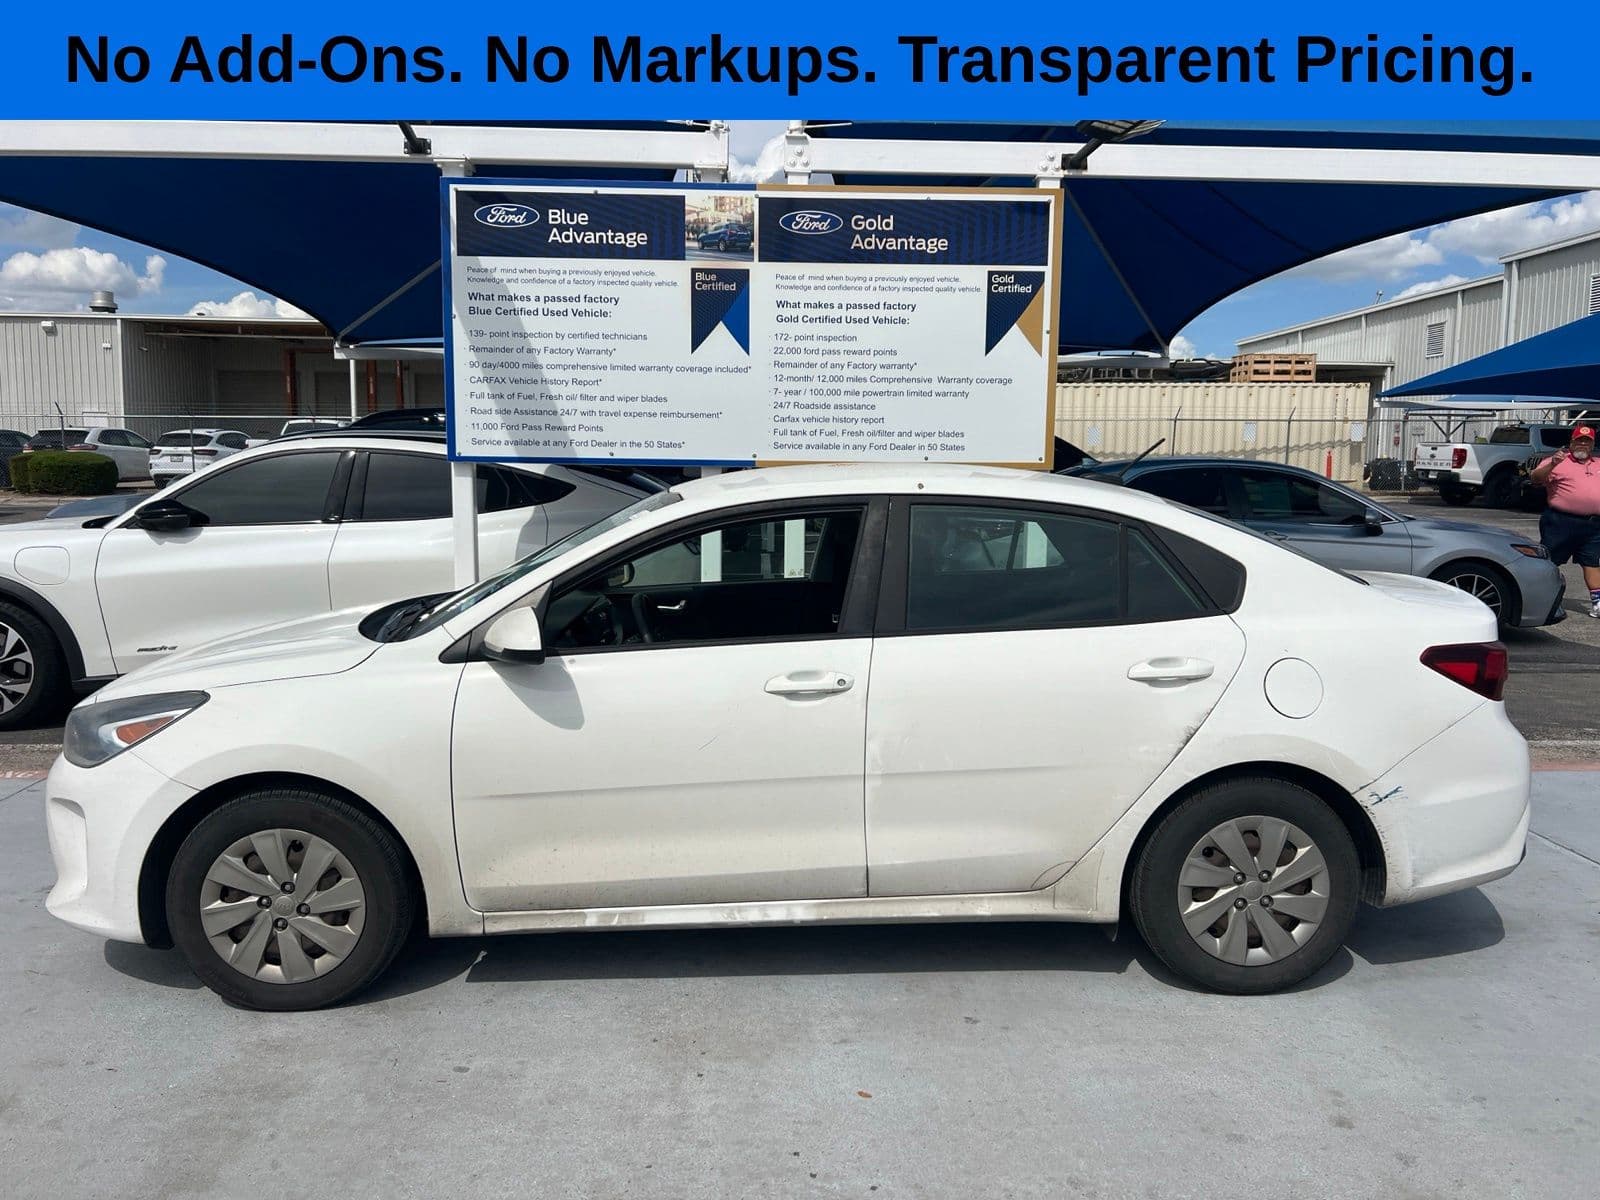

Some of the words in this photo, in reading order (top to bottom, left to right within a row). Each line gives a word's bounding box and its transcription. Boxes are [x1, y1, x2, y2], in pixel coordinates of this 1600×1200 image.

[548, 210, 588, 225] Blue
[851, 215, 893, 230] Gold
[548, 228, 648, 247] Advantage
[851, 234, 948, 253] Advantage
[466, 276, 504, 284] Knowledge
[596, 278, 629, 286] inspected
[695, 272, 717, 281] Blue
[992, 275, 1014, 284] Gold
[695, 282, 736, 291] Certified
[992, 284, 1032, 293] Certified
[467, 292, 494, 301] What
[497, 292, 531, 301] makes
[543, 293, 580, 304] passed
[583, 294, 619, 305] factory
[775, 300, 800, 308] What
[803, 301, 834, 309] makes
[845, 301, 880, 311] passed
[882, 302, 916, 311] factory
[468, 306, 492, 315] Blue
[494, 307, 538, 316] Certified
[541, 307, 568, 316] Used
[570, 308, 611, 317] Vehicle:
[775, 314, 799, 323] Gold
[801, 314, 842, 323] Certified
[844, 315, 869, 324] Used
[871, 316, 909, 324] Vehicle:
[488, 330, 509, 339] point
[511, 331, 553, 340] inspection
[555, 331, 565, 340] by
[794, 333, 814, 342] point
[816, 334, 857, 342] inspection
[468, 345, 513, 353] Remainder
[543, 346, 574, 356] Factory
[872, 348, 897, 357] points
[481, 361, 520, 370] day/4000
[545, 362, 607, 372] comprehensive
[638, 364, 673, 373] warranty
[675, 366, 712, 374] coverage
[846, 361, 877, 371] Factory
[540, 377, 569, 387] History
[774, 374, 814, 382] 12-month/
[817, 374, 844, 382] 12,000
[845, 375, 867, 383] miles
[869, 375, 932, 385] Comprehensive
[937, 375, 973, 385] Warranty
[975, 377, 1012, 385] coverage
[616, 394, 639, 403] wiper
[862, 389, 904, 398] powertrain
[934, 390, 969, 398] warranty
[773, 401, 791, 409] 24/7
[793, 401, 831, 409] Roadside
[833, 402, 876, 410] assistance
[831, 416, 859, 424] history
[860, 416, 884, 425] report
[471, 422, 498, 430] 11,000
[500, 422, 519, 430] Ford
[521, 423, 542, 431] Pass
[544, 423, 576, 431] Reward
[577, 423, 603, 431] Points
[914, 430, 936, 438] wiper
